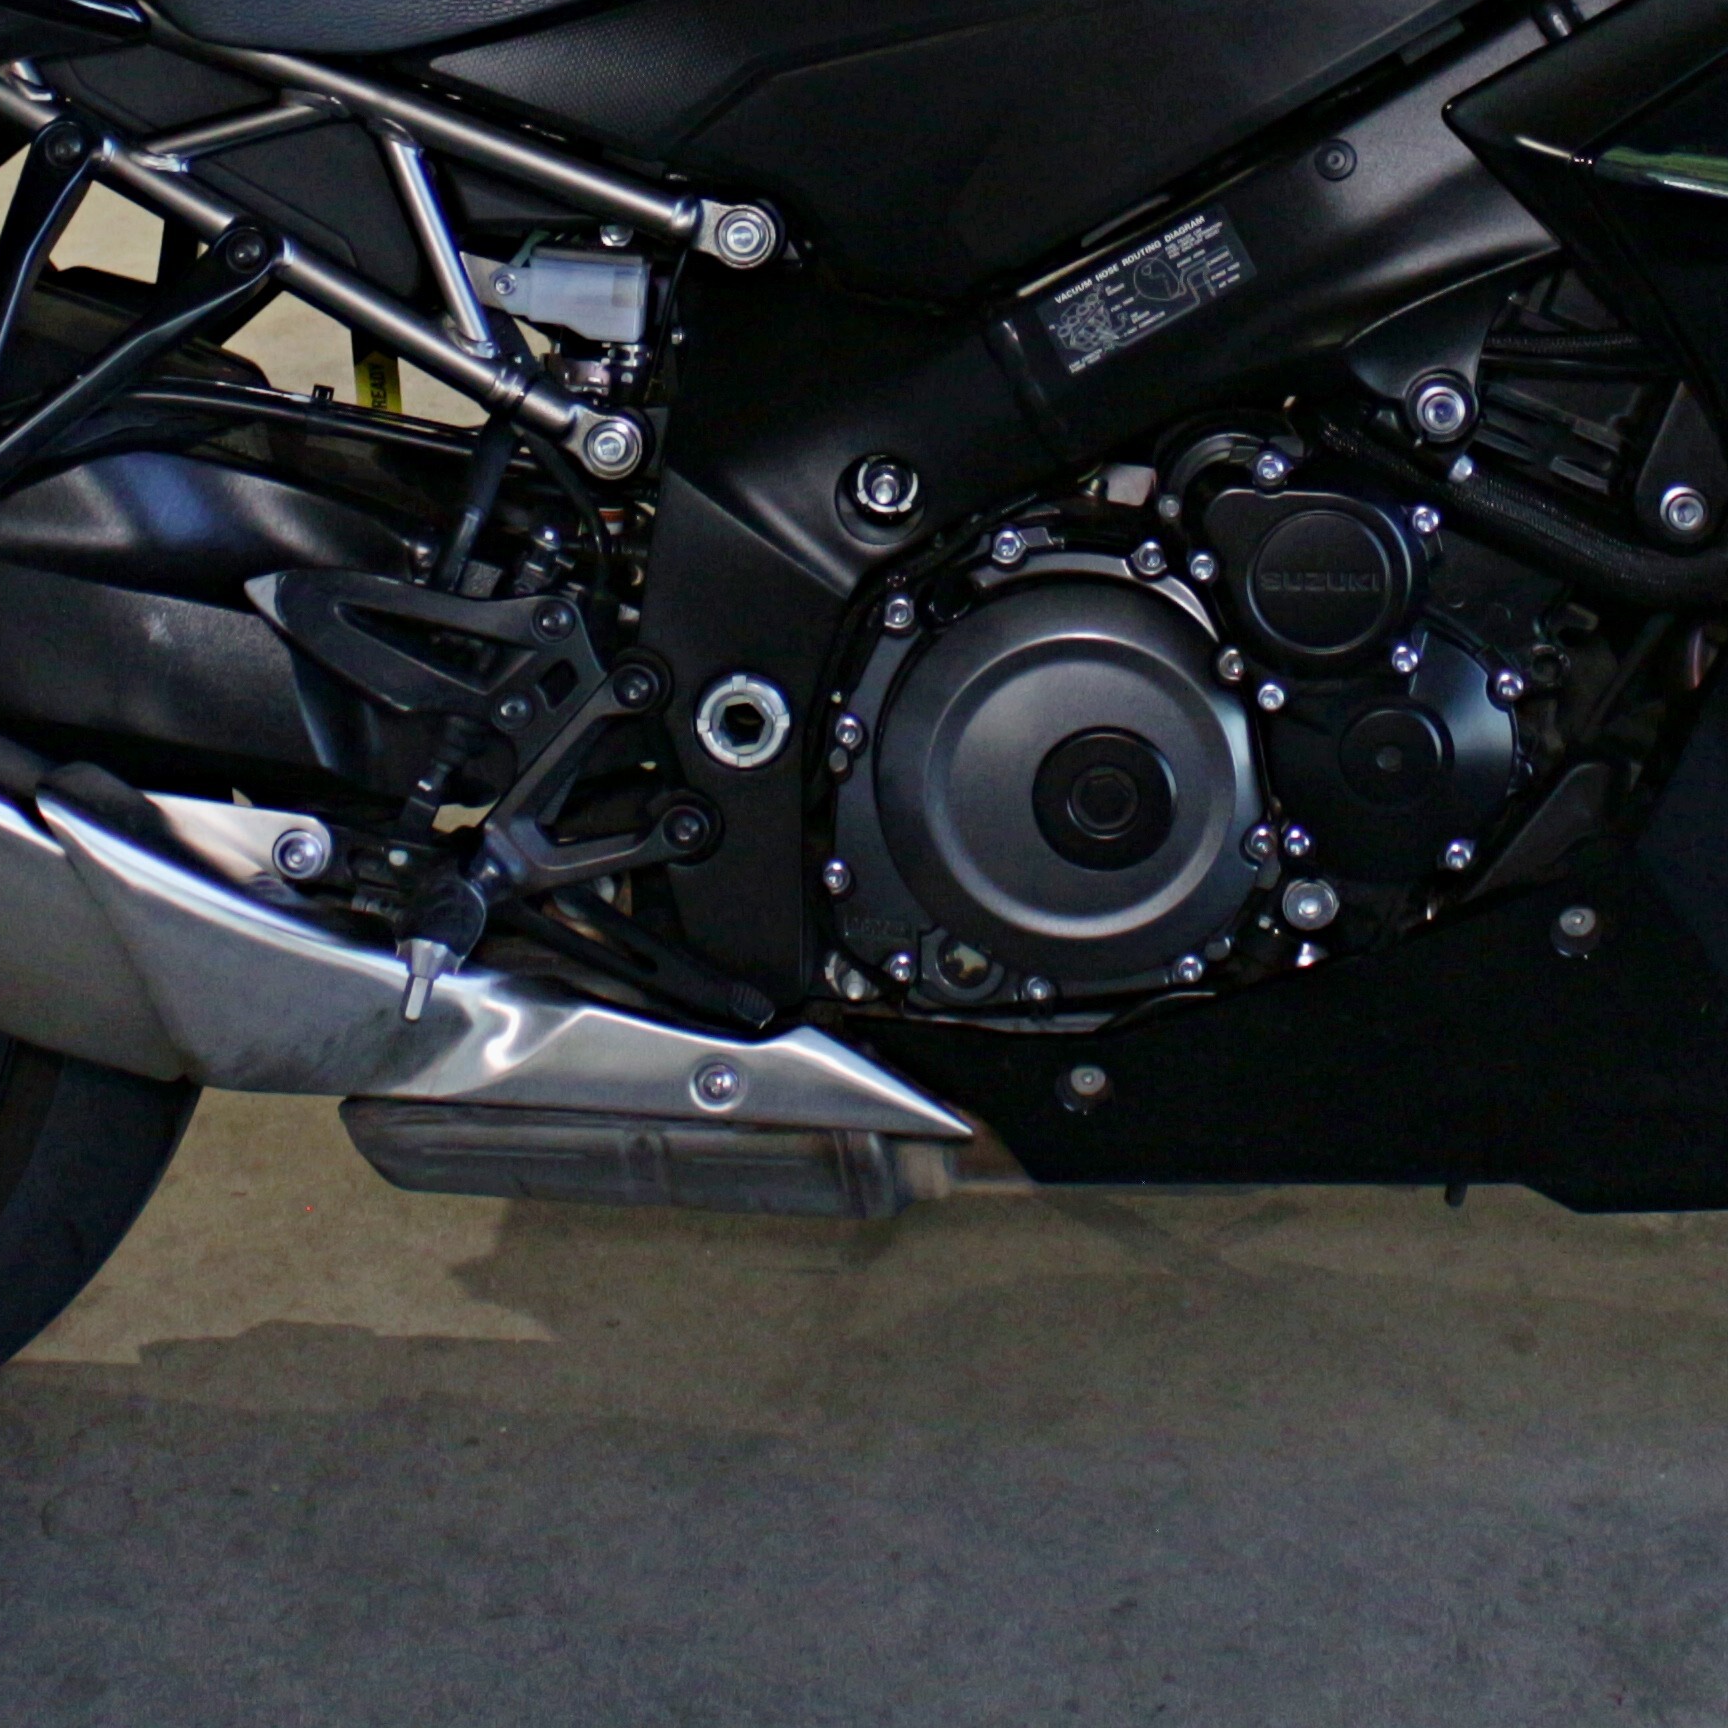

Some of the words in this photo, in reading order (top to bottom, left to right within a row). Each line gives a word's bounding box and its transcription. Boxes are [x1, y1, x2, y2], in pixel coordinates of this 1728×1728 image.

[1054, 279, 1093, 304] VACUUM
[1095, 265, 1120, 283] HOSE
[1121, 240, 1162, 267] ROUTING
[1164, 215, 1206, 243] DIAGRAM
[368, 362, 388, 408] READY
[1259, 571, 1380, 593] SUZUKI
